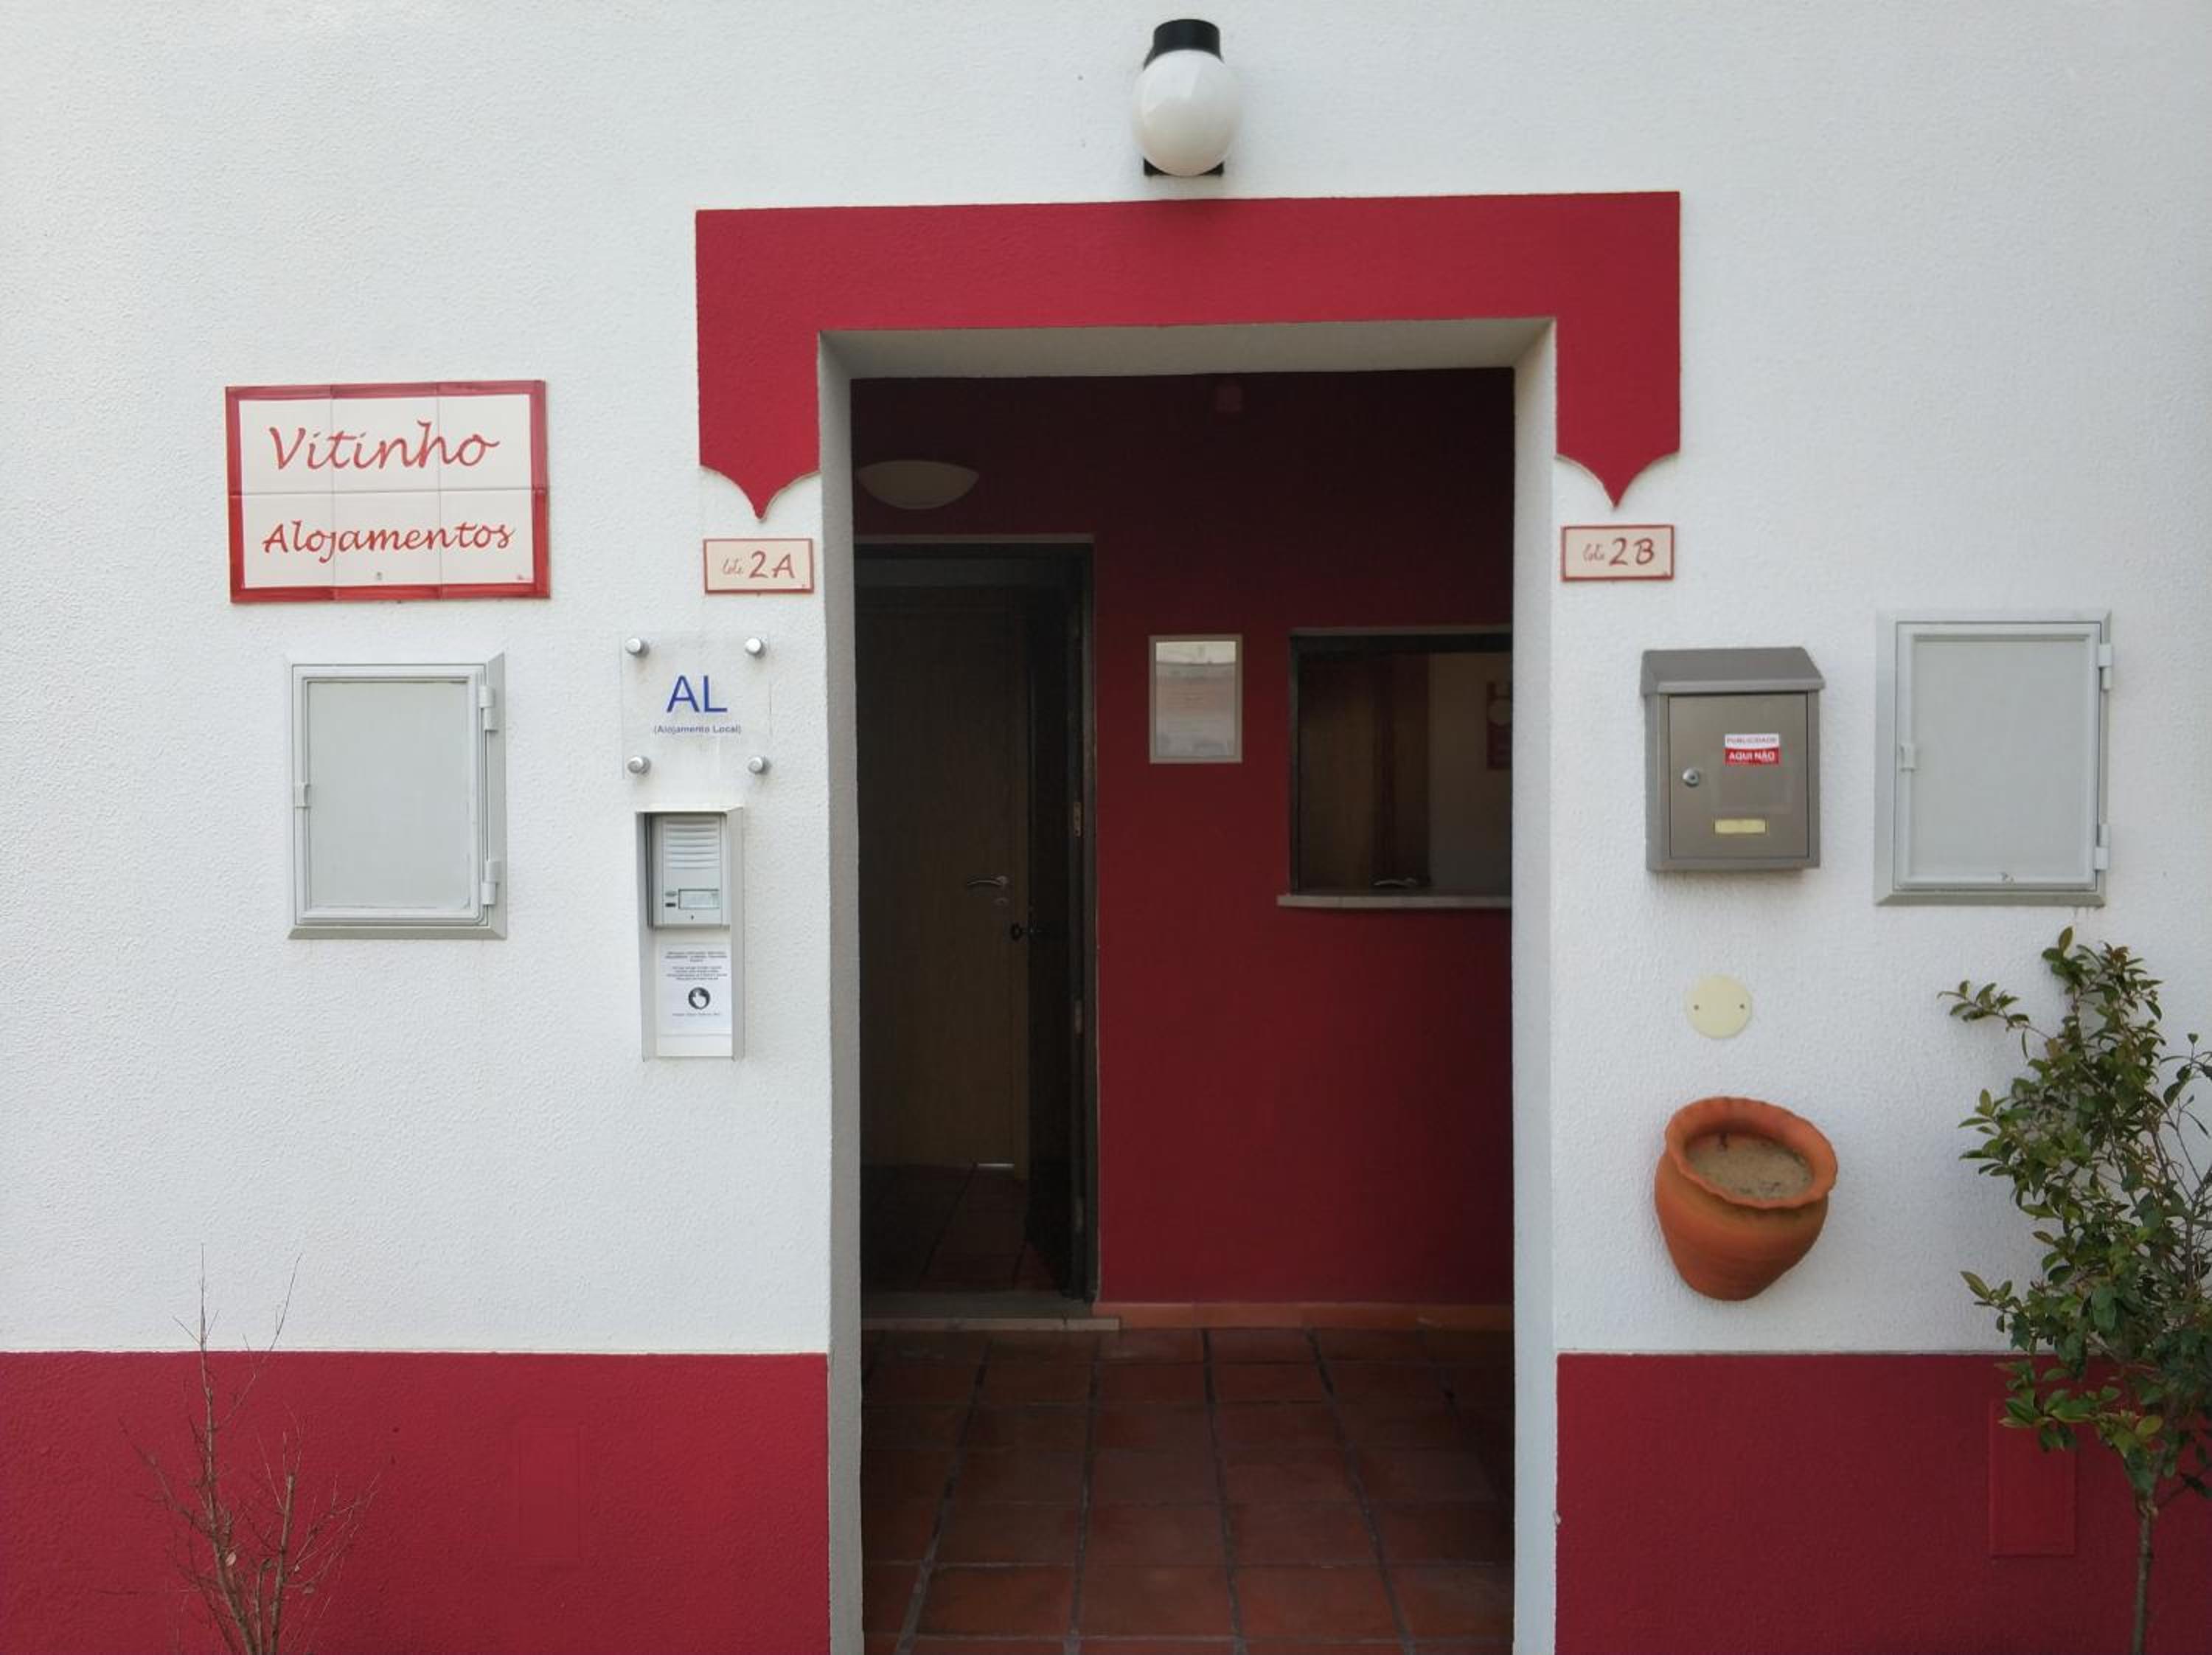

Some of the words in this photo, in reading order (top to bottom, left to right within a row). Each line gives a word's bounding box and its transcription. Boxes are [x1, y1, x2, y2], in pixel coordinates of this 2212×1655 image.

[269, 420, 501, 471] Vitinho
[262, 519, 516, 563] Alojamentos
[1609, 536, 1655, 566] 2B
[748, 550, 796, 579] 2A
[667, 675, 728, 713] AL
[653, 725, 710, 735] (Alojamento
[712, 724, 742, 735] Local)
[1729, 751, 1753, 760] AQUI
[1755, 749, 1775, 762] NÃO
